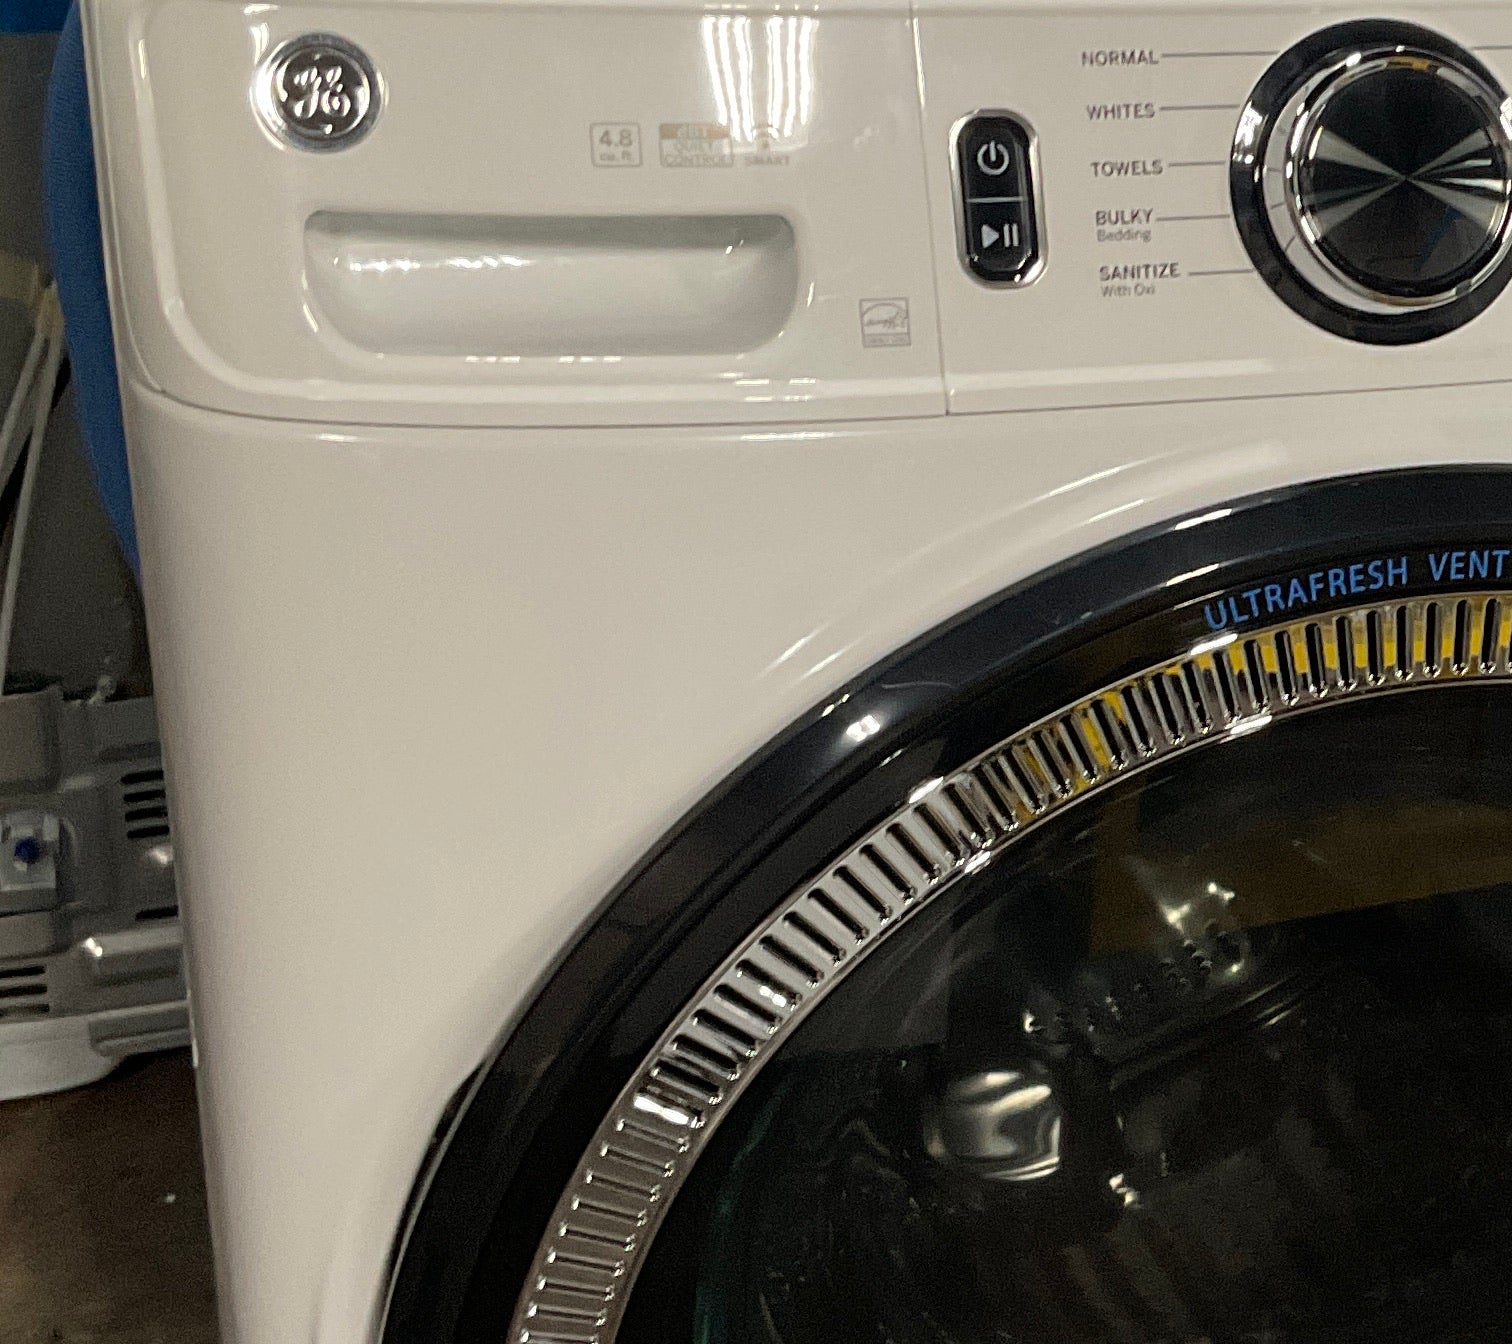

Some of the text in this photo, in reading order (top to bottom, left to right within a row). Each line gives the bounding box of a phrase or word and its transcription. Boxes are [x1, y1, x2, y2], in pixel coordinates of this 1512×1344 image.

[1081, 50, 1159, 67] NORMAL
[1086, 103, 1156, 120] WHITES
[599, 129, 633, 146] 4.8
[1090, 160, 1163, 177] TOWELS
[1096, 208, 1153, 226] BULKY
[1097, 227, 1152, 244] Bedding
[1099, 262, 1179, 281] SANITIZE
[1100, 283, 1131, 298] With
[1203, 555, 1408, 630] ULTRAFRESH
[1428, 550, 1509, 581] VENT
